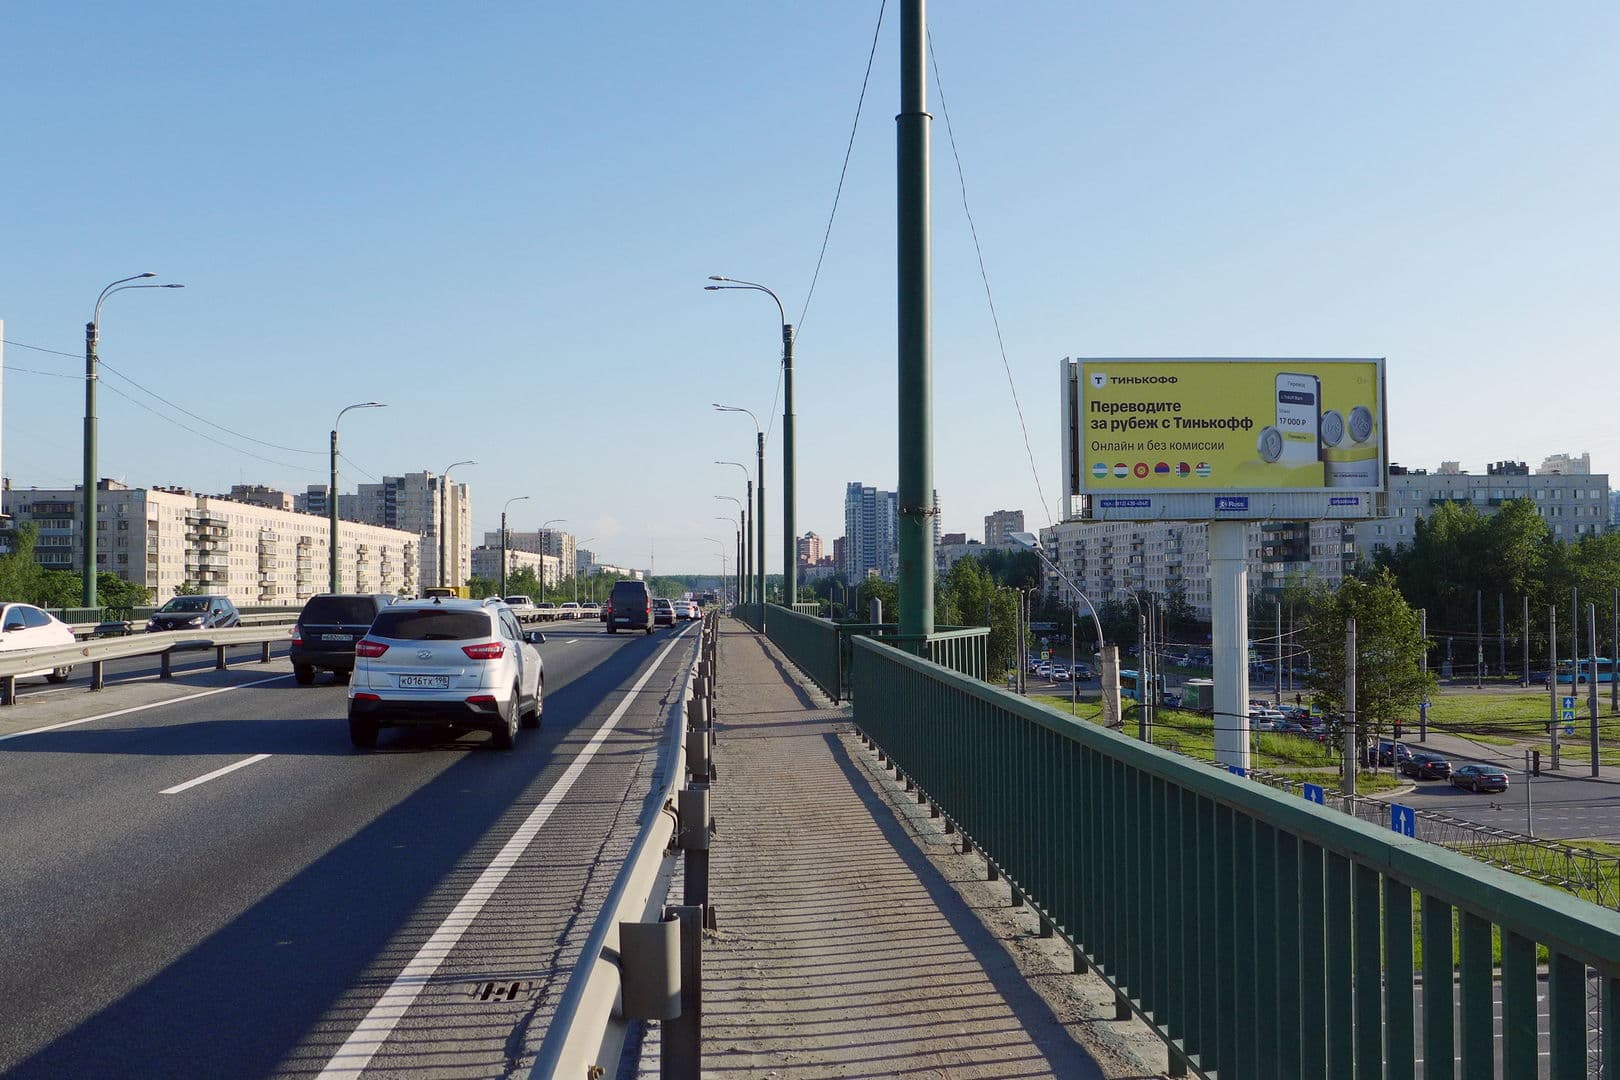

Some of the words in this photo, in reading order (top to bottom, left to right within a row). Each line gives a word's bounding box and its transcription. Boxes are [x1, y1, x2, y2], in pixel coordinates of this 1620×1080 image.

[1110, 376, 1178, 384] ТИНЬКОФФ
[1090, 401, 1182, 415] Переводите
[1090, 419, 1108, 430] за
[1111, 417, 1159, 432] рубеж
[1161, 419, 1171, 429] с
[1173, 416, 1254, 431] Тинькофф
[1091, 440, 1135, 452] Онлайн
[1137, 443, 1144, 451] и
[1147, 440, 1167, 451] без
[1169, 442, 1225, 451] комиссии
